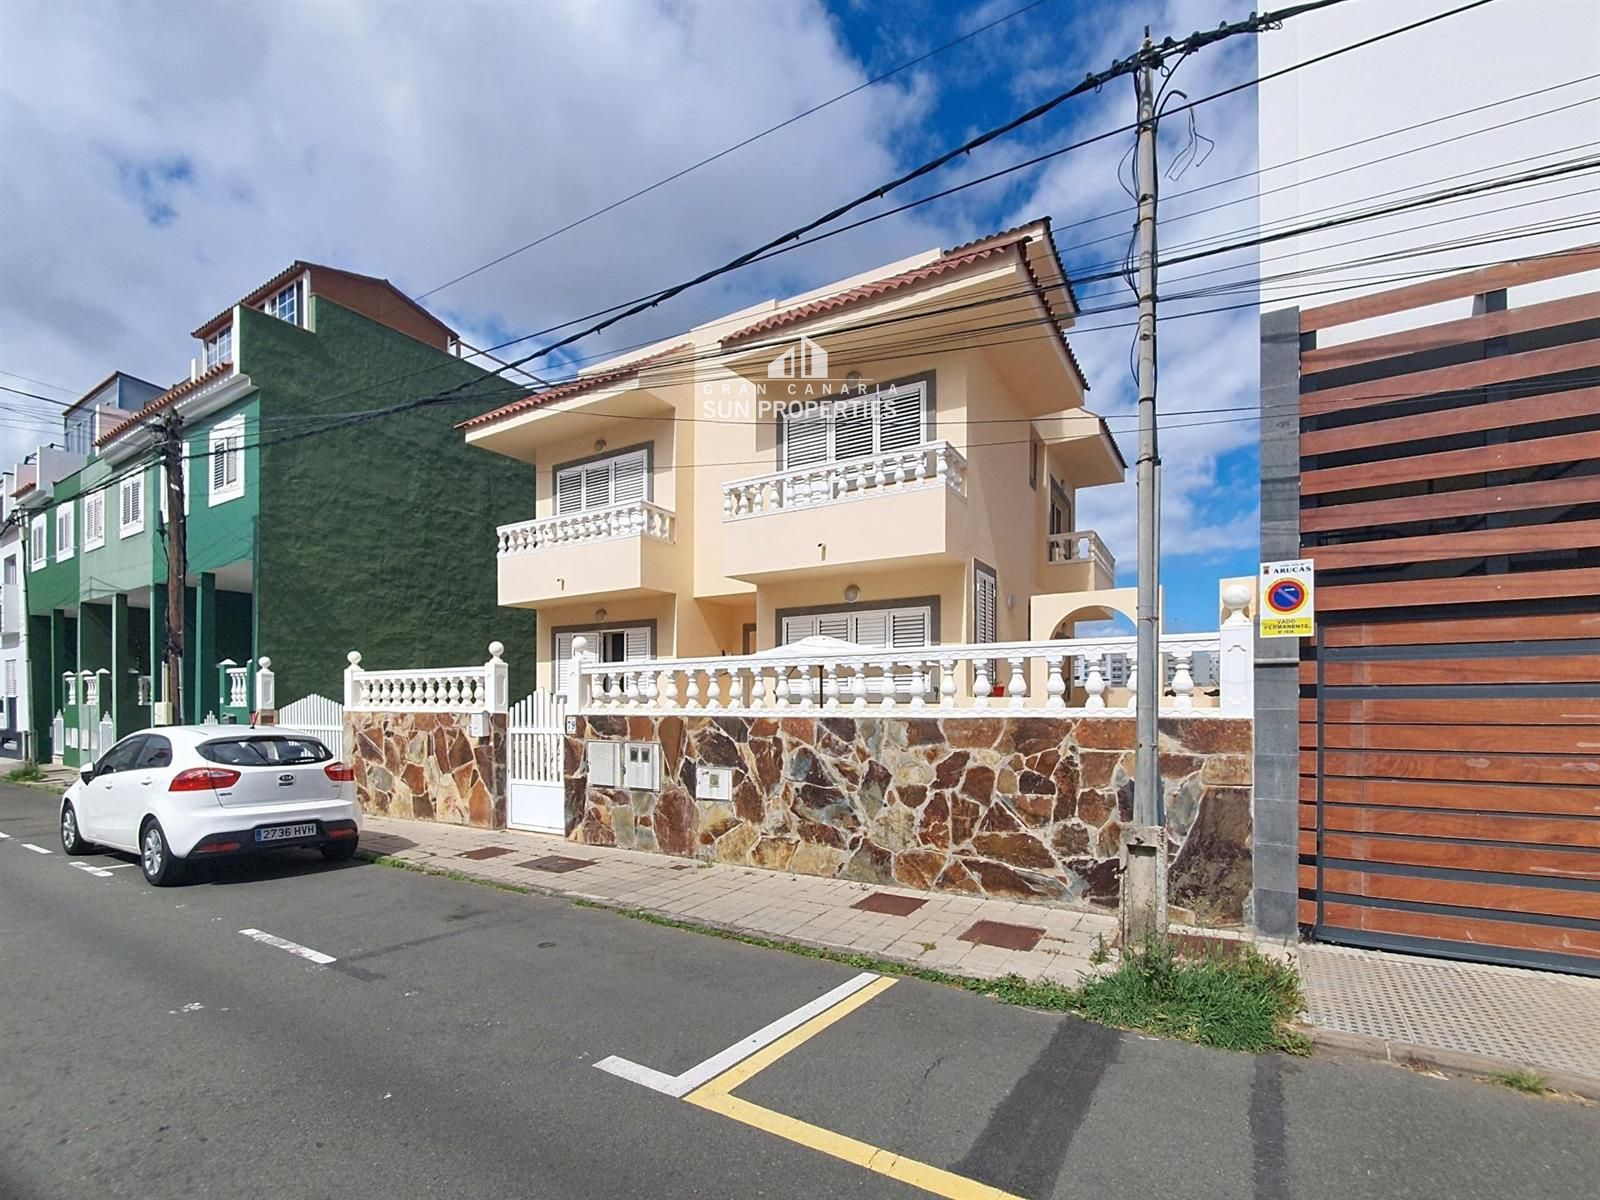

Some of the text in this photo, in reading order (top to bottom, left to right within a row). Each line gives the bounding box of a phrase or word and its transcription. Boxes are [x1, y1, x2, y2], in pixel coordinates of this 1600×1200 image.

[1273, 566, 1311, 574] ARUCAS
[263, 825, 314, 839] 2736 HVH
